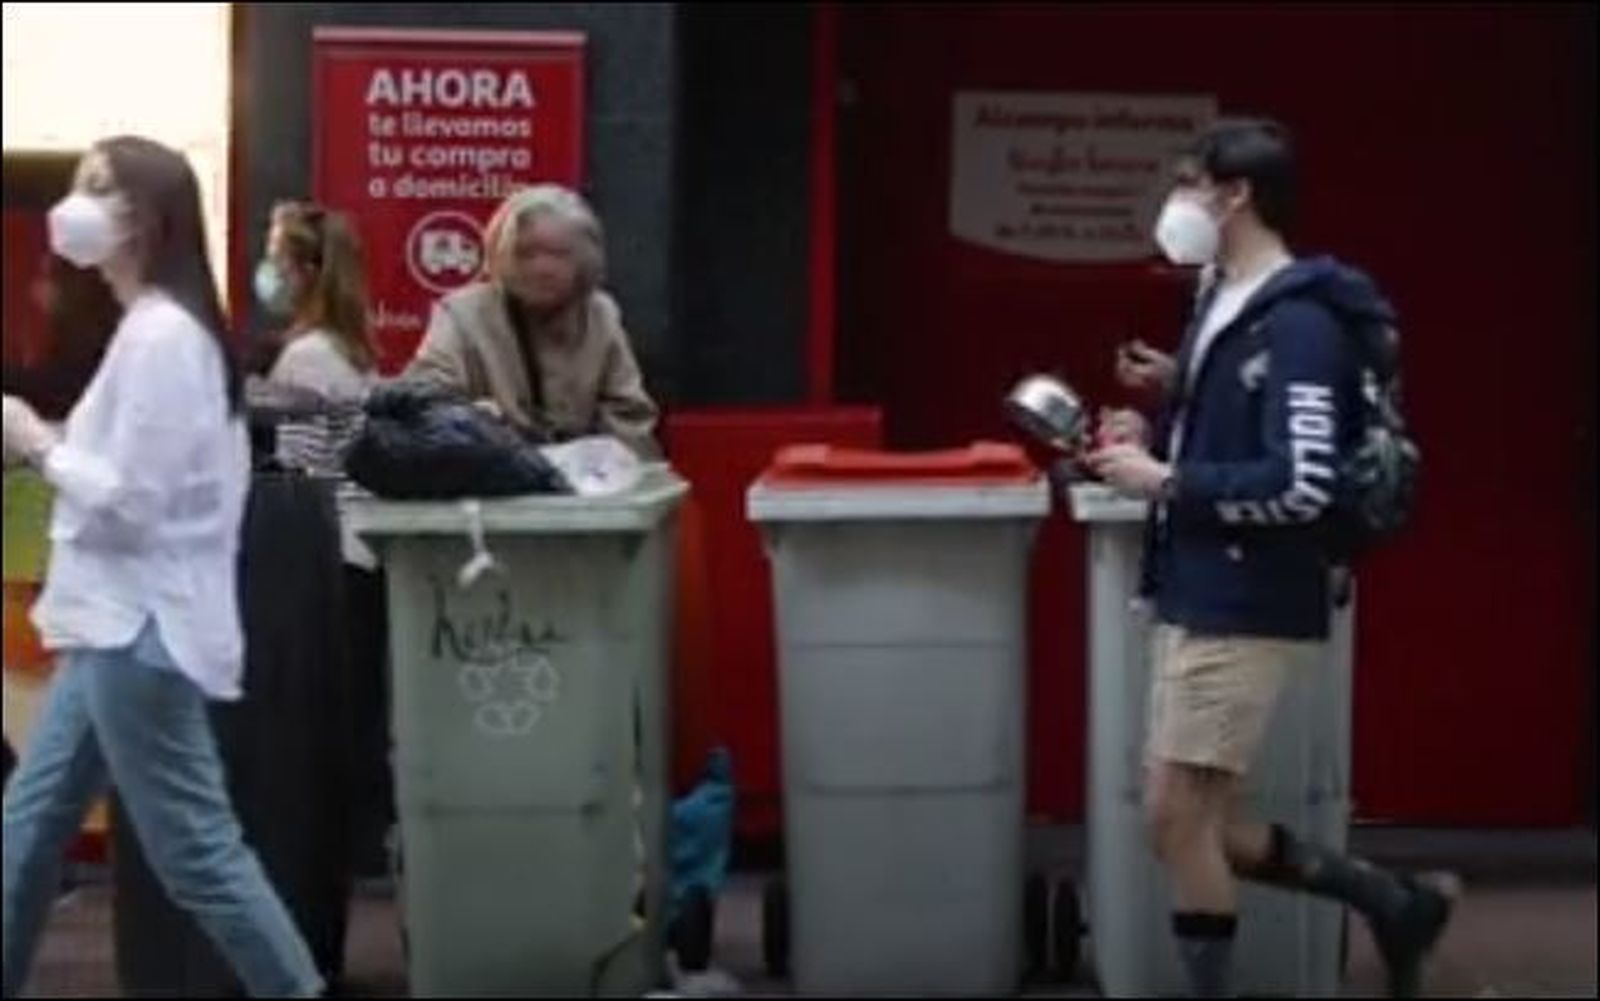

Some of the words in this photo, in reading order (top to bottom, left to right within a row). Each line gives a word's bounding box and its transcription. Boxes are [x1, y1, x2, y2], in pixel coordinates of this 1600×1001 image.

[366, 69, 535, 107] AHORA
[368, 113, 396, 136] te
[403, 112, 531, 137] llevamos
[368, 142, 402, 166] tu
[409, 147, 531, 173] compra
[368, 178, 387, 198] a
